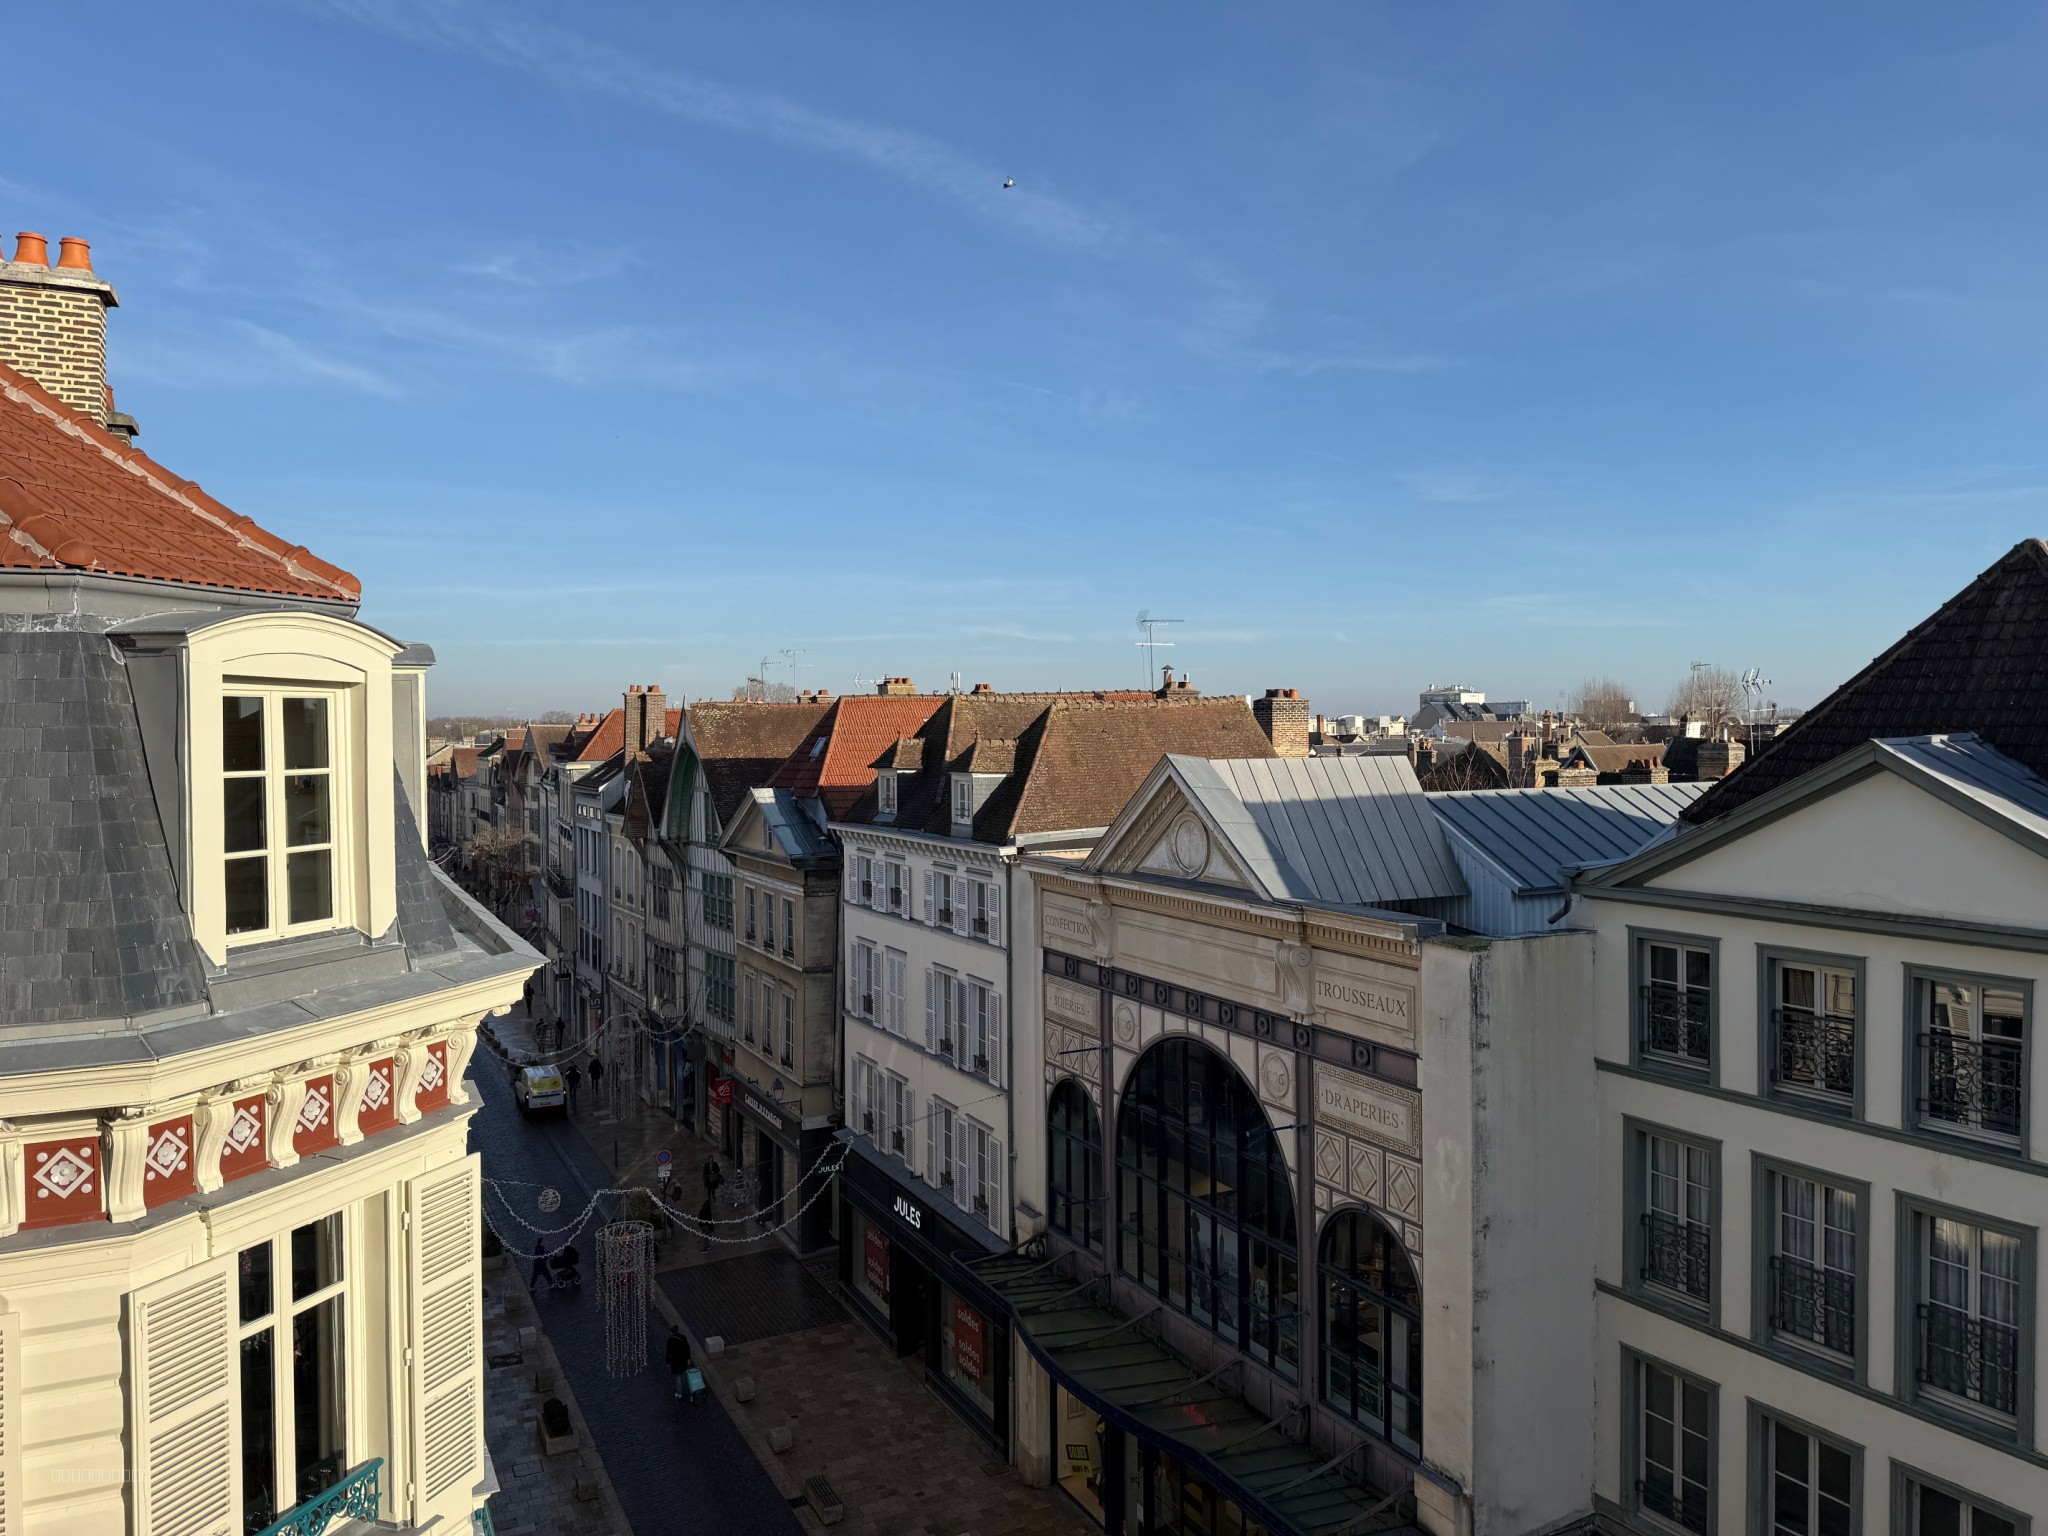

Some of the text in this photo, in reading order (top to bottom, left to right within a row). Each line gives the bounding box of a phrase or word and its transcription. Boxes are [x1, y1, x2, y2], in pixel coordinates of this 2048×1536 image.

[1045, 914, 1090, 936] CONFECTION
[1053, 994, 1086, 1016] SOIERIES
[1316, 980, 1406, 1017] TROUSSEAUX
[1325, 1089, 1399, 1129] DRAPERIES
[893, 1195, 921, 1229] JULES
[957, 1308, 979, 1333] soldes
[958, 1339, 980, 1364] soldes
[958, 1354, 980, 1379] soldes
